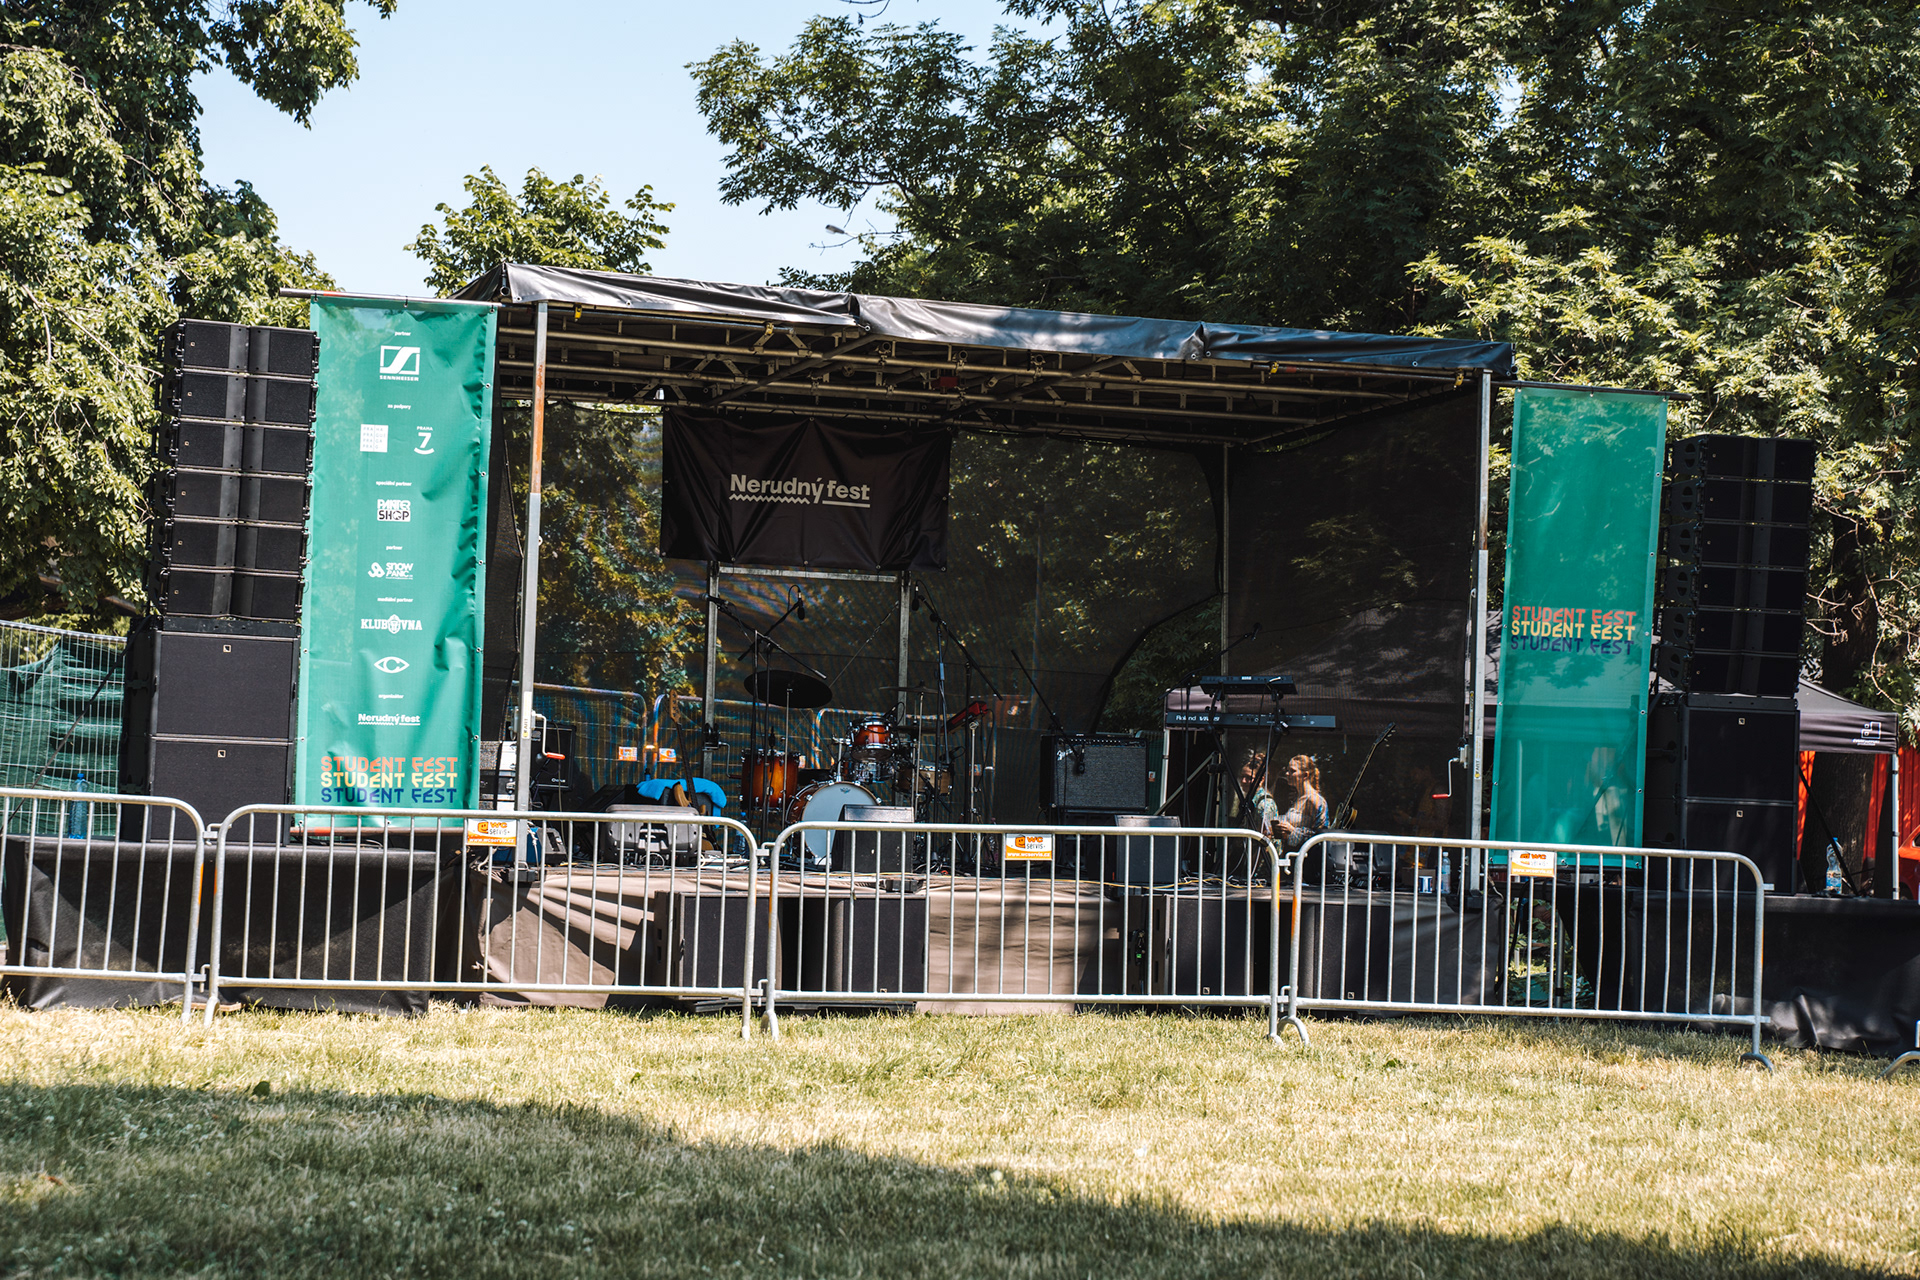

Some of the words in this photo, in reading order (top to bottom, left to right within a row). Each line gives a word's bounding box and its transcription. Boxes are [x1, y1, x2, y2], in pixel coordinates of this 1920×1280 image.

[418, 432, 432, 449] 7
[730, 474, 824, 504] Nerudný
[827, 480, 871, 501] fest
[378, 510, 410, 521] SHOP
[1511, 605, 1586, 624] STUDENT
[1591, 609, 1637, 626] FEST
[1511, 619, 1585, 639] STUDENT
[1590, 623, 1636, 641] FEST
[1510, 634, 1583, 653] STUDENT
[1589, 638, 1634, 655] FEST
[358, 713, 400, 726] Nerudný
[400, 714, 421, 723] fest
[320, 756, 406, 772] STUDENT
[411, 757, 458, 772] FEST
[320, 772, 406, 788] STUDENT
[411, 772, 458, 788] FEST
[321, 787, 405, 803] STUDENT
[411, 788, 457, 803] FEST
